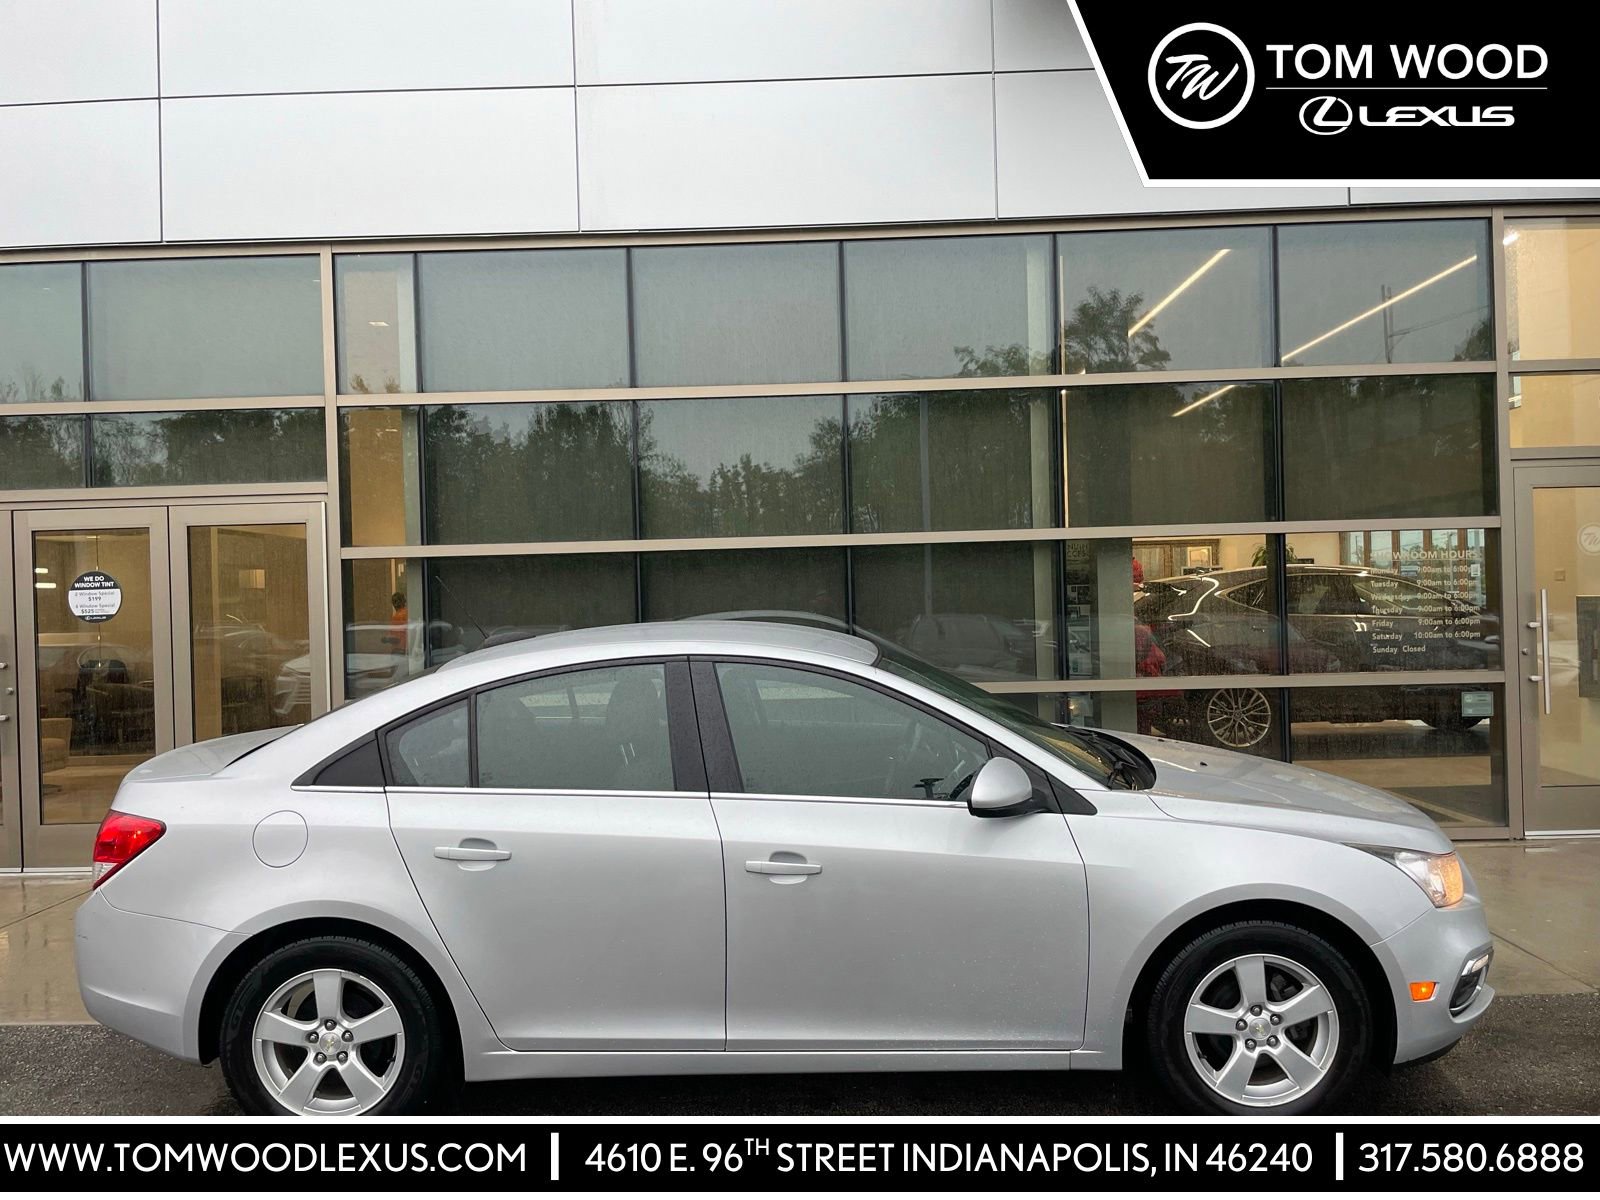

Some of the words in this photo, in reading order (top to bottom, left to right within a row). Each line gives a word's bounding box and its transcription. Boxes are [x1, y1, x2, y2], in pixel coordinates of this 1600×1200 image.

[1441, 550, 1479, 560] HOURS
[1443, 565, 1452, 573] to
[1371, 580, 1399, 589] Tuesday
[1416, 579, 1442, 587] 9:00am
[1416, 592, 1443, 600] 9:00am
[1444, 592, 1452, 600] to
[1371, 605, 1403, 615] Thursday
[1417, 605, 1443, 613] 9:00am
[1454, 604, 1481, 613] 6:00pm
[1372, 619, 1394, 628] Friday
[1417, 618, 1444, 626] 9:00am
[1454, 617, 1481, 626] 6:00pm
[1372, 632, 1403, 641] Saturday
[1413, 631, 1444, 639] 10:00am
[1454, 630, 1481, 639] 6:00pm
[1372, 645, 1399, 655] Sunday
[1402, 644, 1426, 653] Closed
